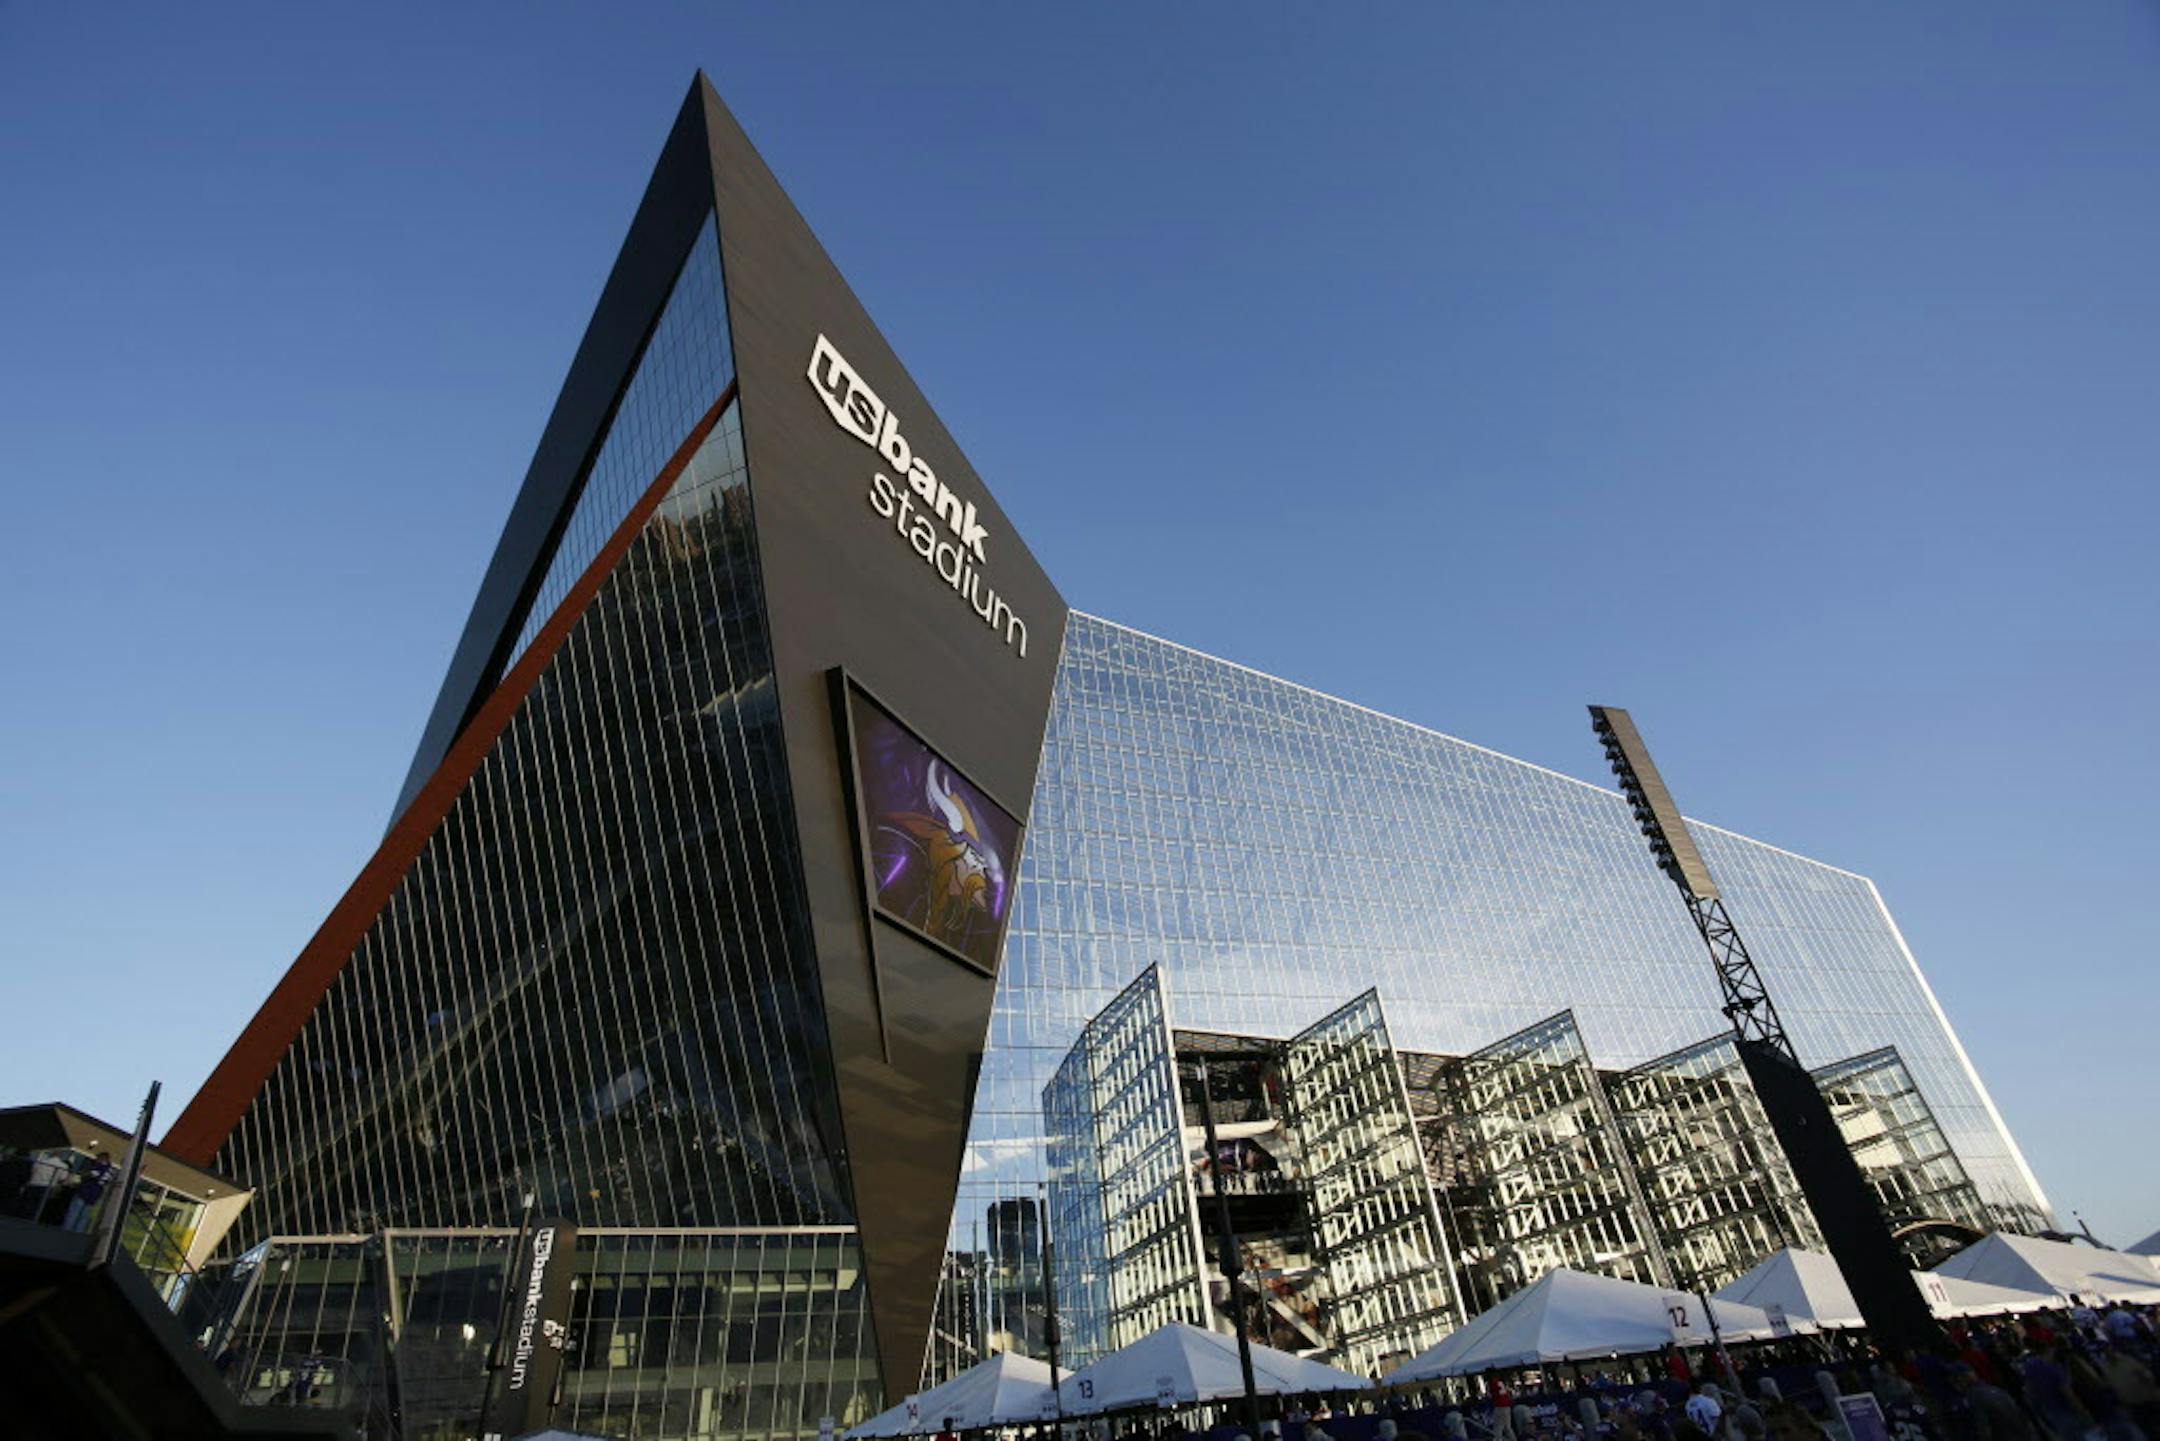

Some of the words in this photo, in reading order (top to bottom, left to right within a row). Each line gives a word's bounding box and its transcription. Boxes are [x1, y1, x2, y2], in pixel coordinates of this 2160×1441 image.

[869, 472, 1028, 658] stadium
[1668, 1306, 1690, 1328] 12
[1078, 1379, 1094, 1399] 13
